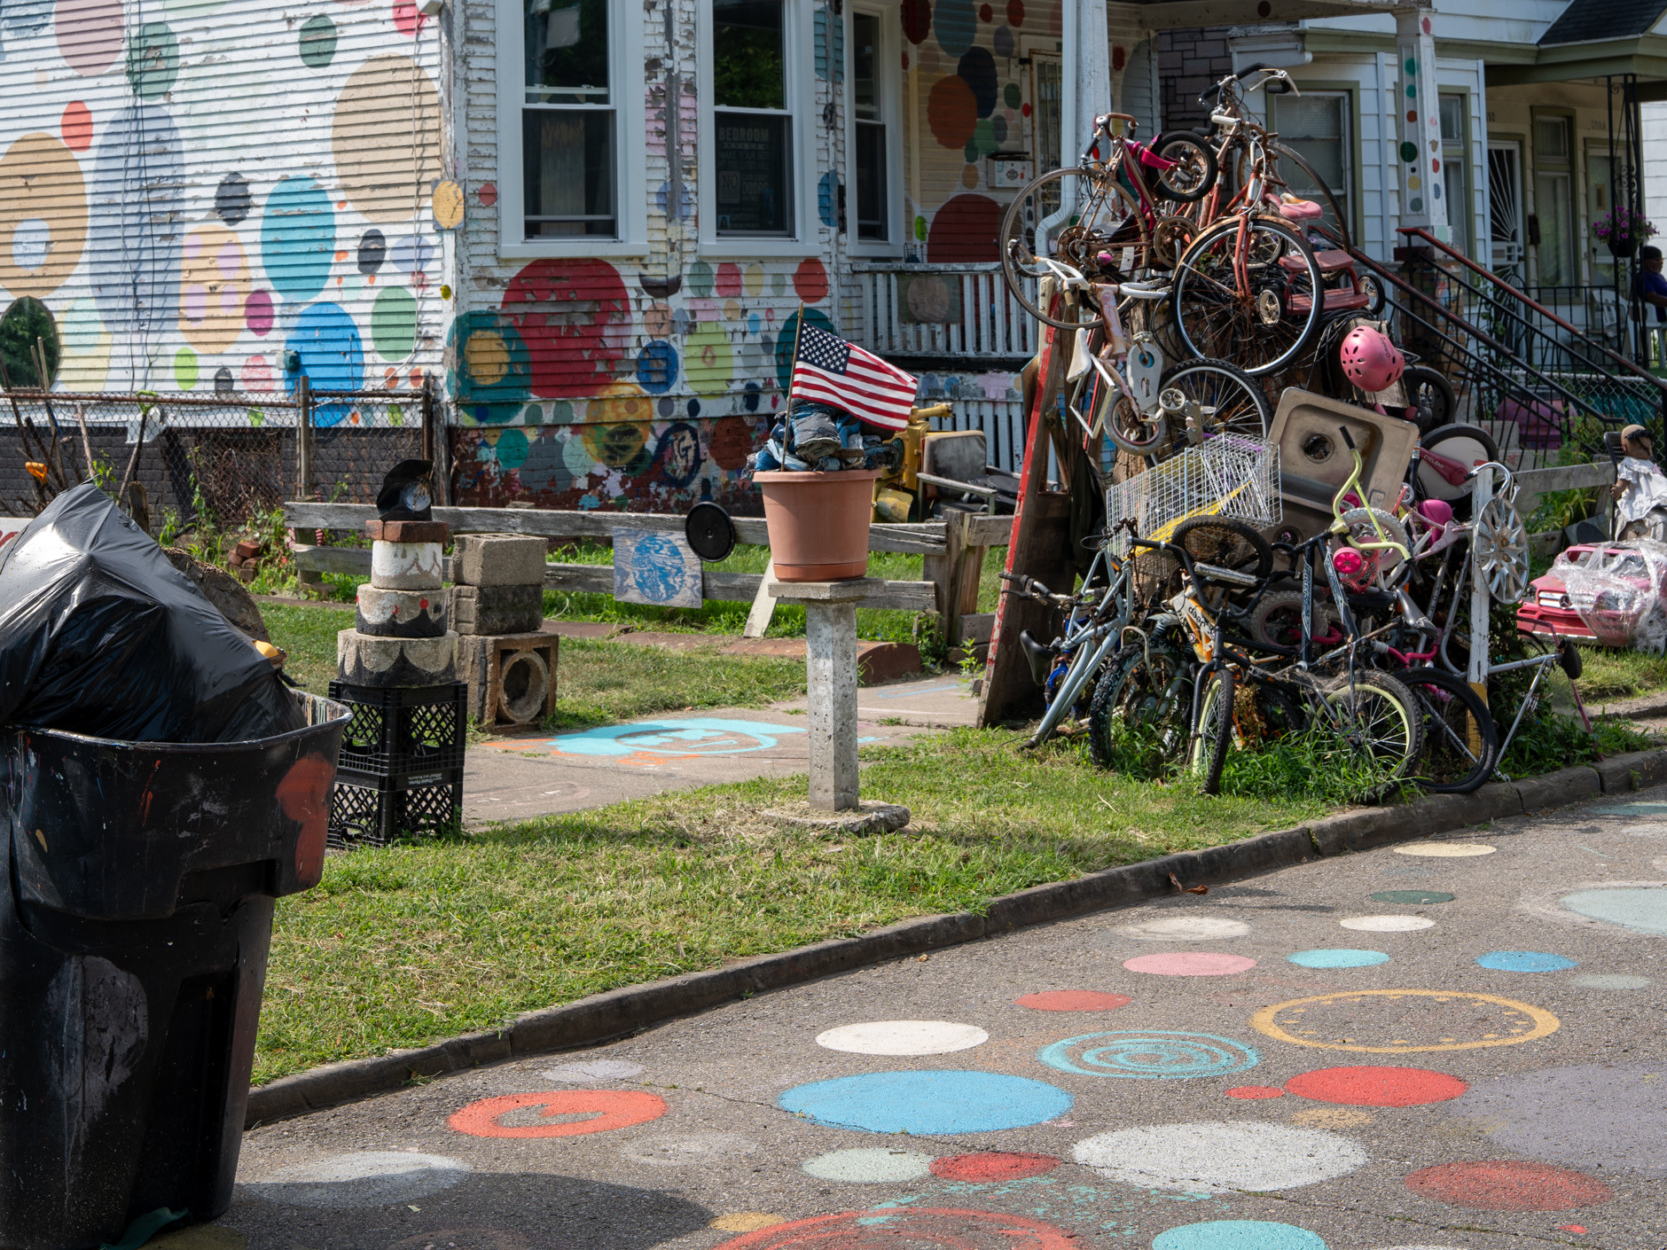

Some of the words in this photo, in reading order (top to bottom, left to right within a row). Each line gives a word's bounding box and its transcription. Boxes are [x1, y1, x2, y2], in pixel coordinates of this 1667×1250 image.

[718, 127, 769, 142] BEDROOM
[722, 174, 738, 189] NO
[1423, 454, 1444, 469] CYCLONE
